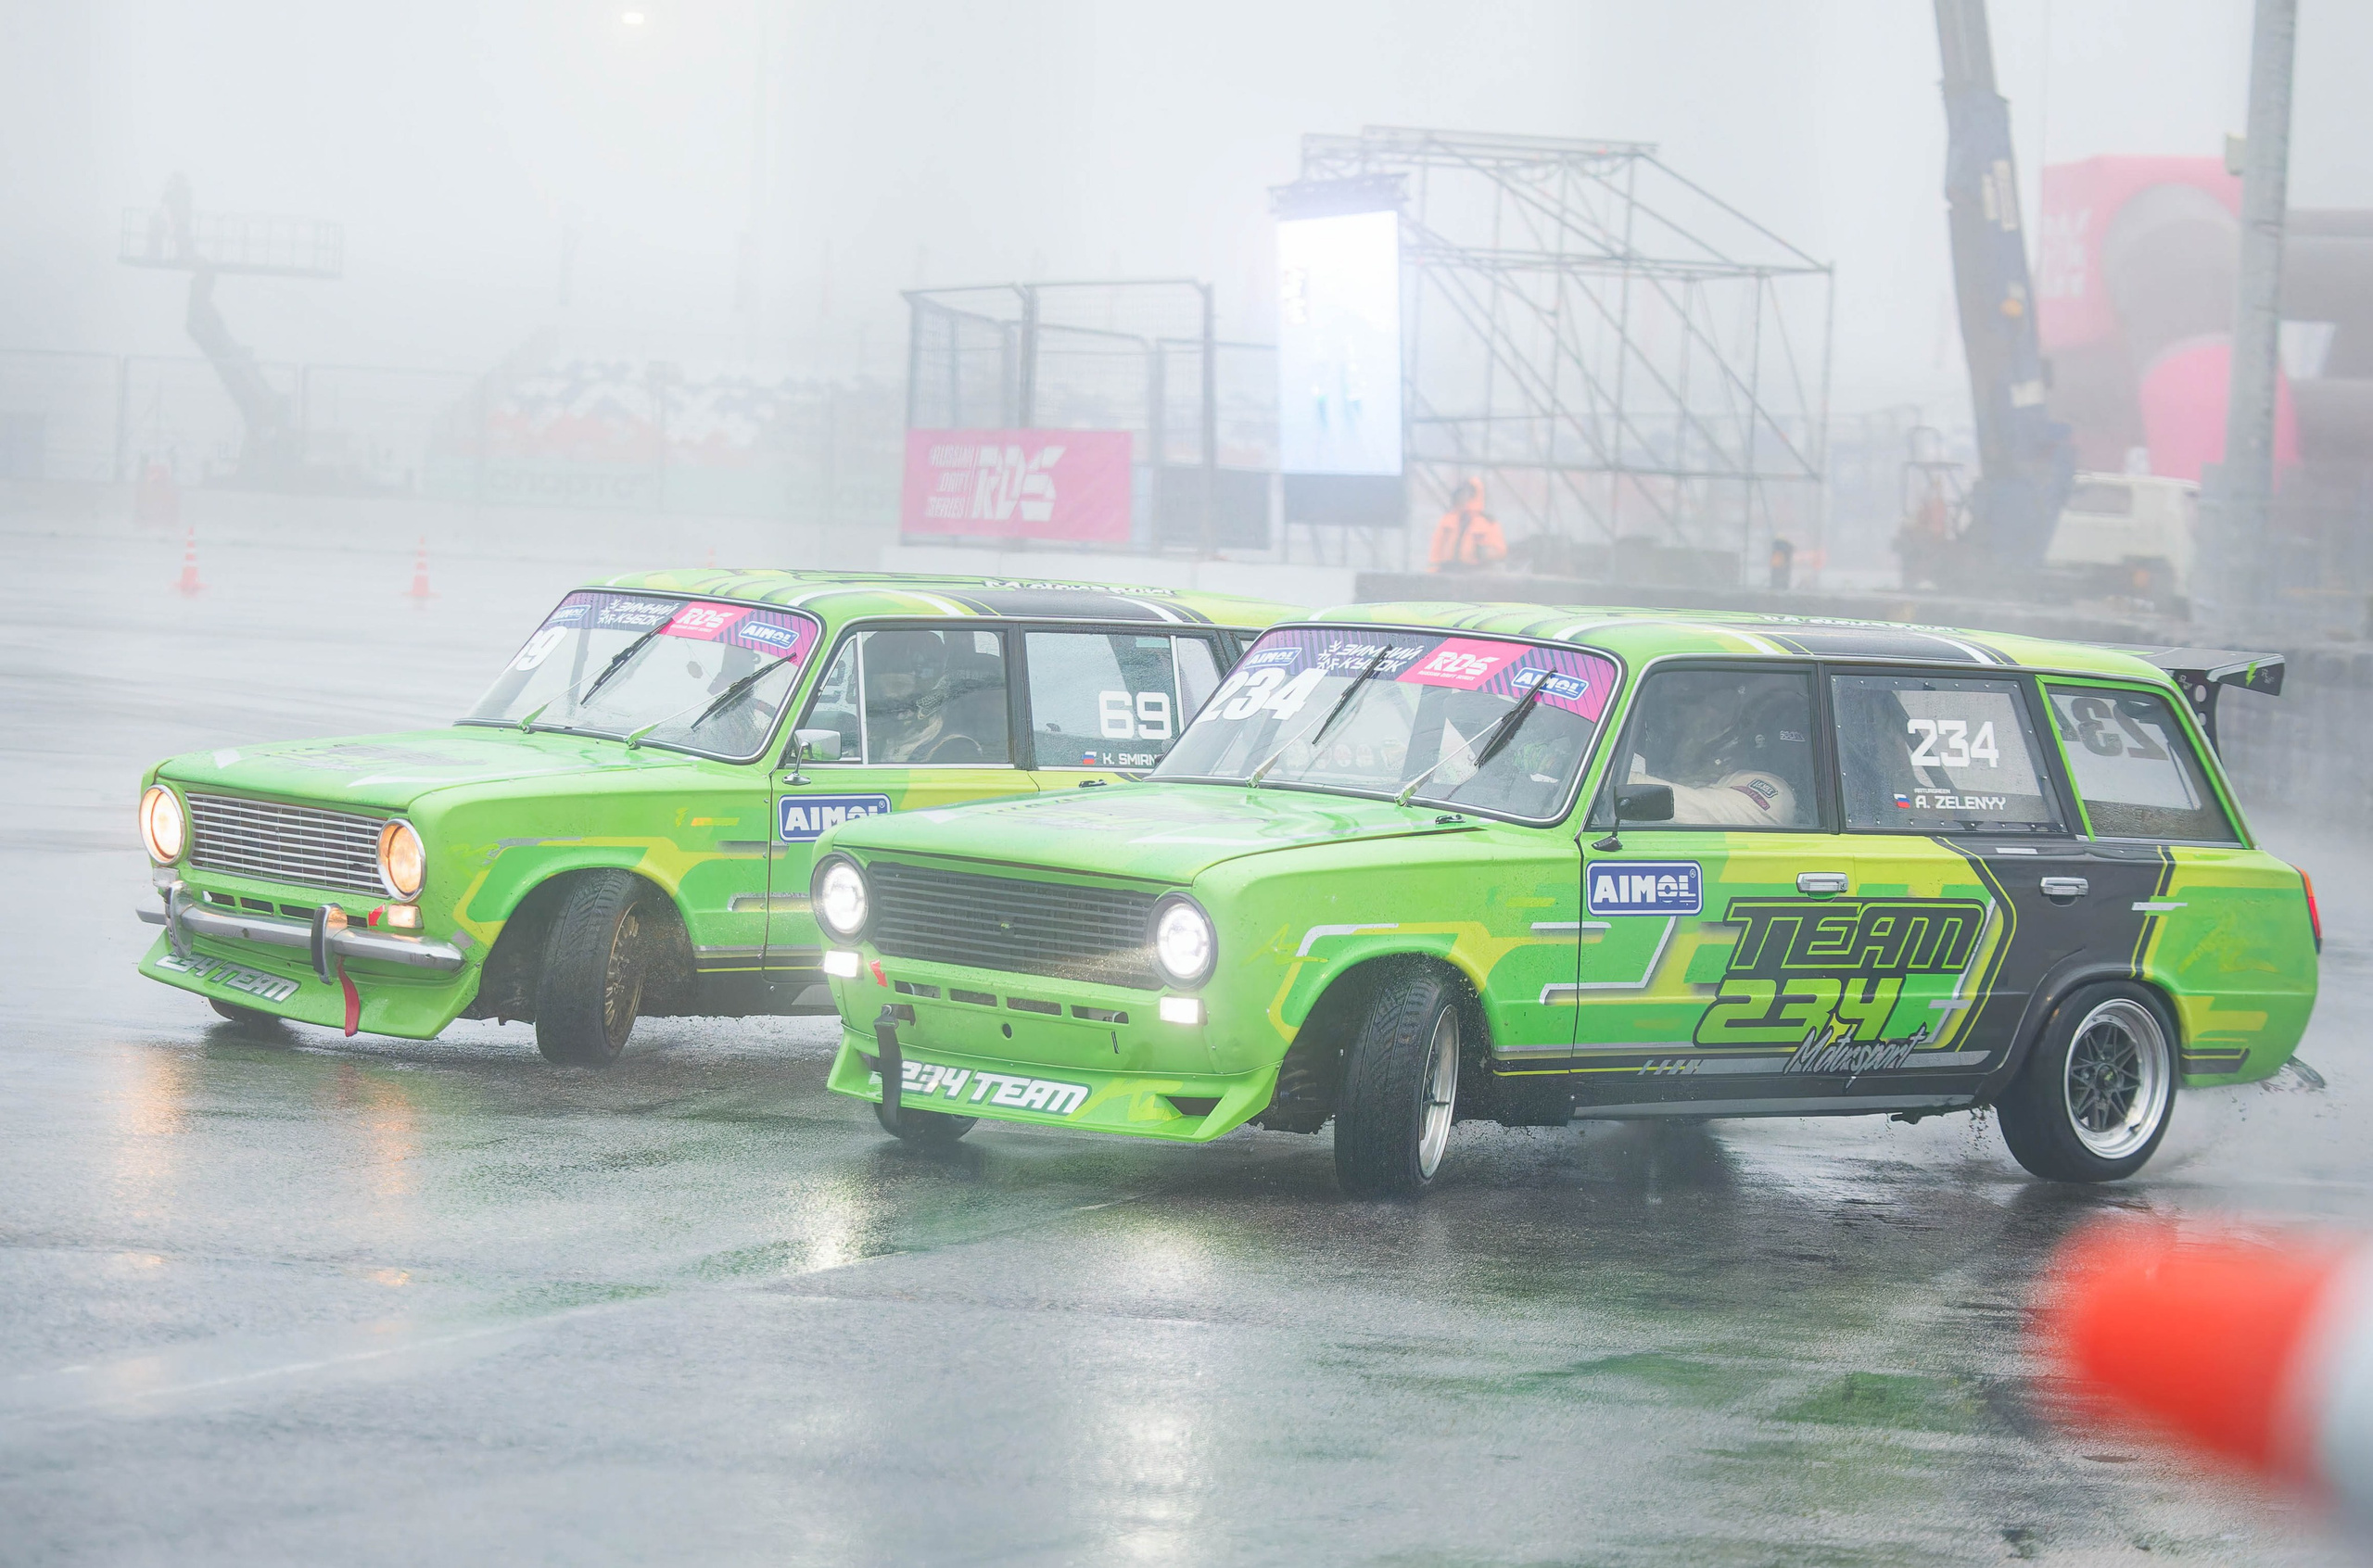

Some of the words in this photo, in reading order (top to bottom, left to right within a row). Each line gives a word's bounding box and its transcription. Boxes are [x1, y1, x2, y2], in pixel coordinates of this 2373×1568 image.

[971, 445, 1068, 522] RDS
[613, 613, 666, 626] КУБОК
[615, 601, 680, 616] ЗИМНИЙ
[677, 608, 734, 628] RDS
[742, 625, 792, 646] AIMOL
[1247, 651, 1293, 665] AIMOL
[1424, 651, 1501, 676] RDS
[1190, 667, 1329, 723] 234
[1098, 690, 1173, 740] 69
[1103, 752, 1115, 765] K.
[1119, 752, 1164, 766] SMIRN
[1908, 719, 1999, 768] 234
[1915, 795, 1931, 809] A.
[1935, 795, 2006, 811] ZELENYY
[1593, 874, 1696, 904] AIMOL
[1726, 900, 1986, 971] TEAM
[209, 961, 300, 1002] TEAM
[1695, 977, 1905, 1045] 234
[1783, 1022, 1929, 1082] Motorsport
[970, 1071, 1090, 1115] TEAM
